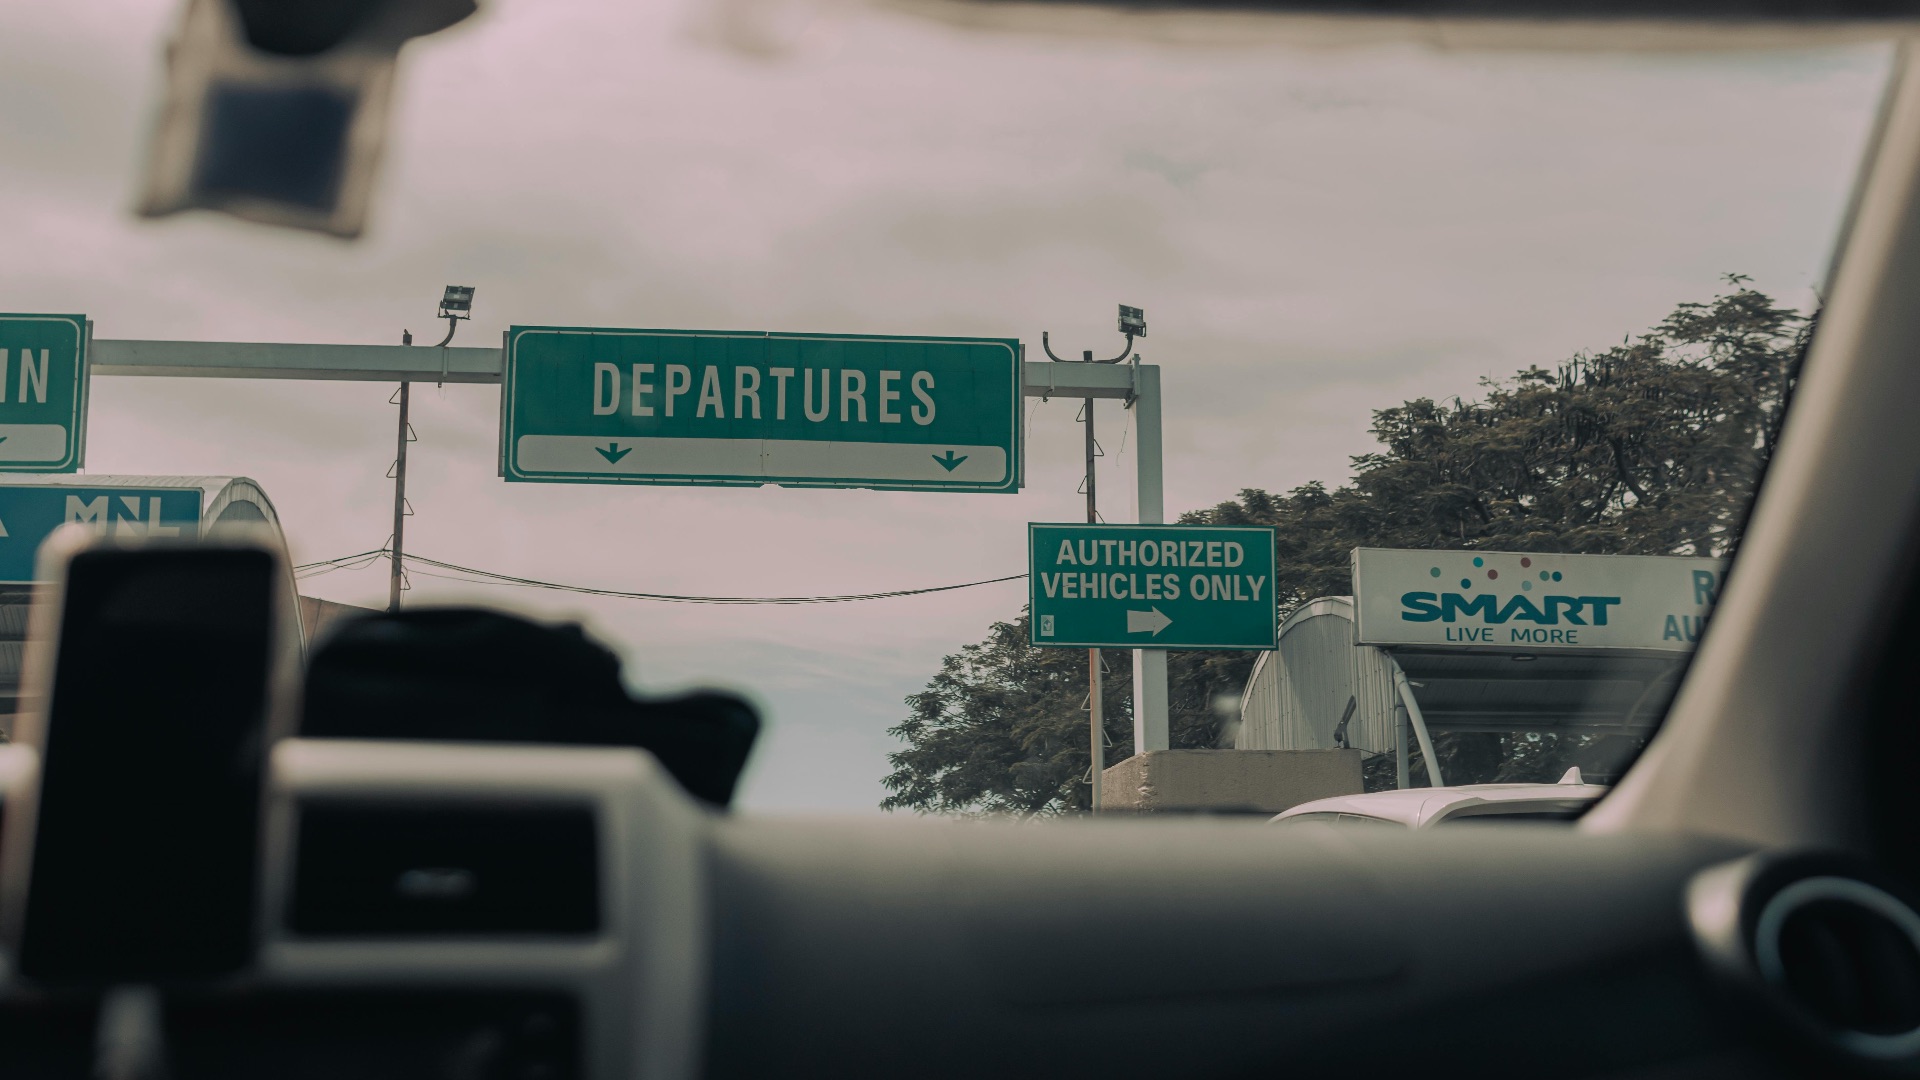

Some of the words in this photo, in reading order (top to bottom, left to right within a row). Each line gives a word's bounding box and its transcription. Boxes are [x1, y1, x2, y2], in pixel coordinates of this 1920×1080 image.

[592, 361, 937, 427] DEPARTURES
[64, 494, 181, 538] MNL
[1056, 539, 1245, 568] AUTHORIZED
[1041, 572, 1181, 600] VEHICLES
[1189, 574, 1266, 602] ONLY
[1400, 590, 1621, 626] SMART
[1445, 627, 1494, 643] LIVE
[1511, 628, 1579, 645] MORE
[1663, 614, 1710, 643] AU
